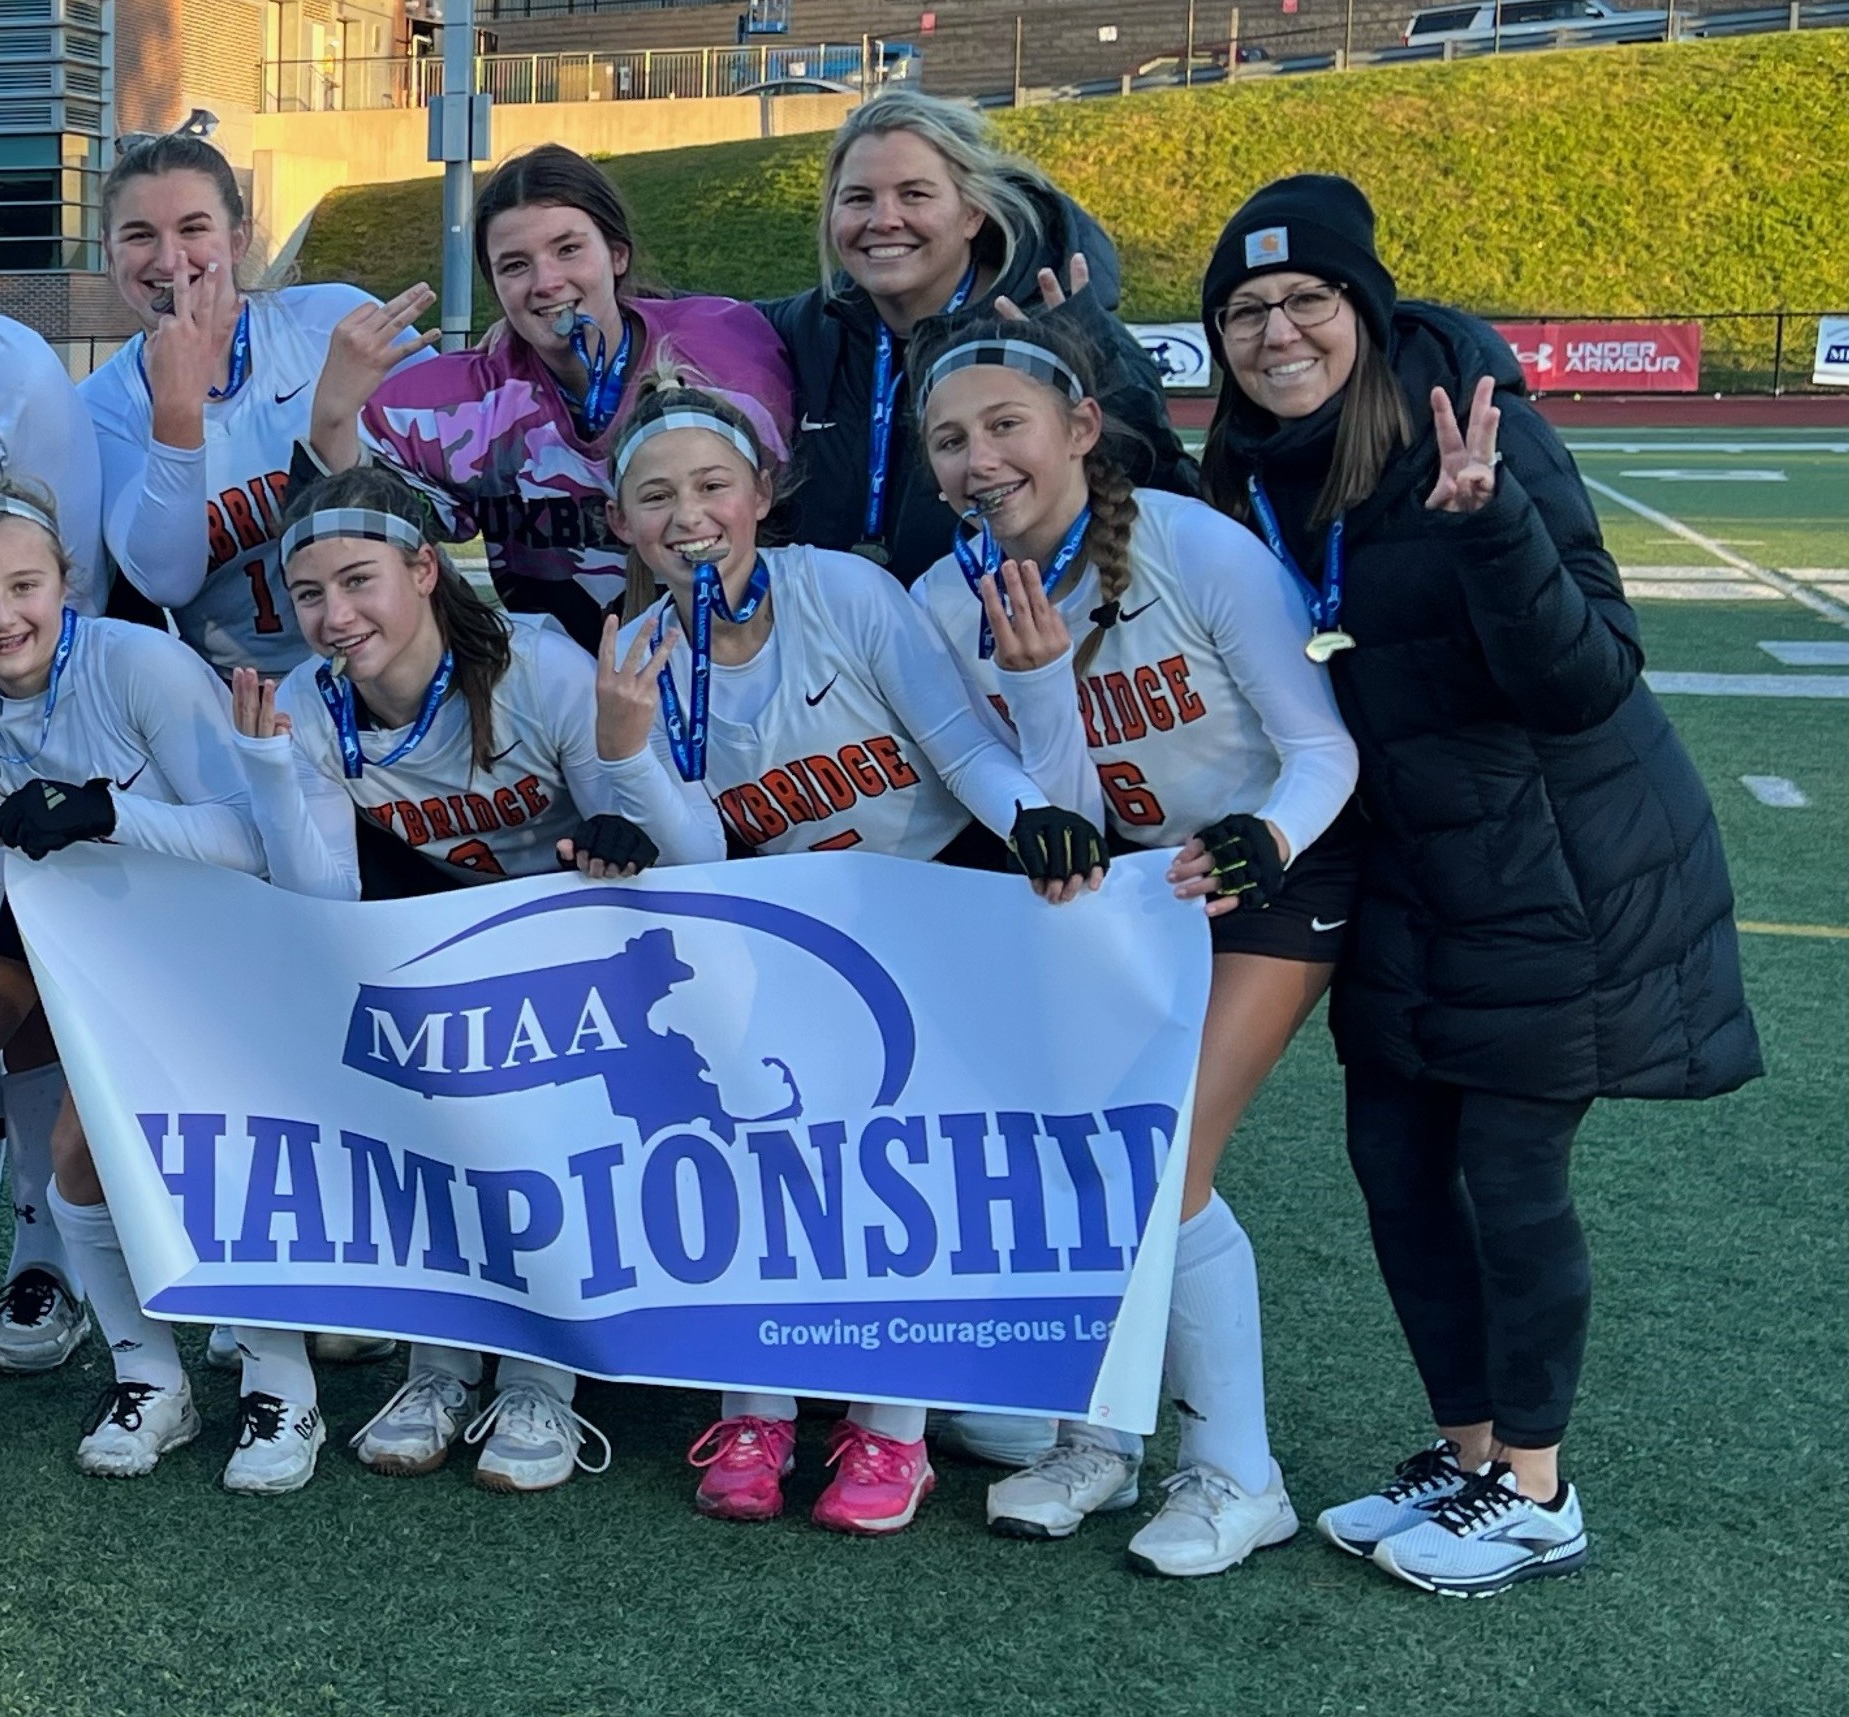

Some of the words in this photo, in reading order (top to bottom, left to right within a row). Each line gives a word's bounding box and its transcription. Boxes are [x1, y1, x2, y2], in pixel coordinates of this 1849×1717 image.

[1565, 356, 1680, 372] ARMOUR
[1566, 341, 1657, 358] UNDER
[1097, 761, 1165, 825] 6
[364, 985, 627, 1076] MIAA
[758, 1319, 880, 1350] Growing
[887, 1317, 1066, 1348] Courageous
